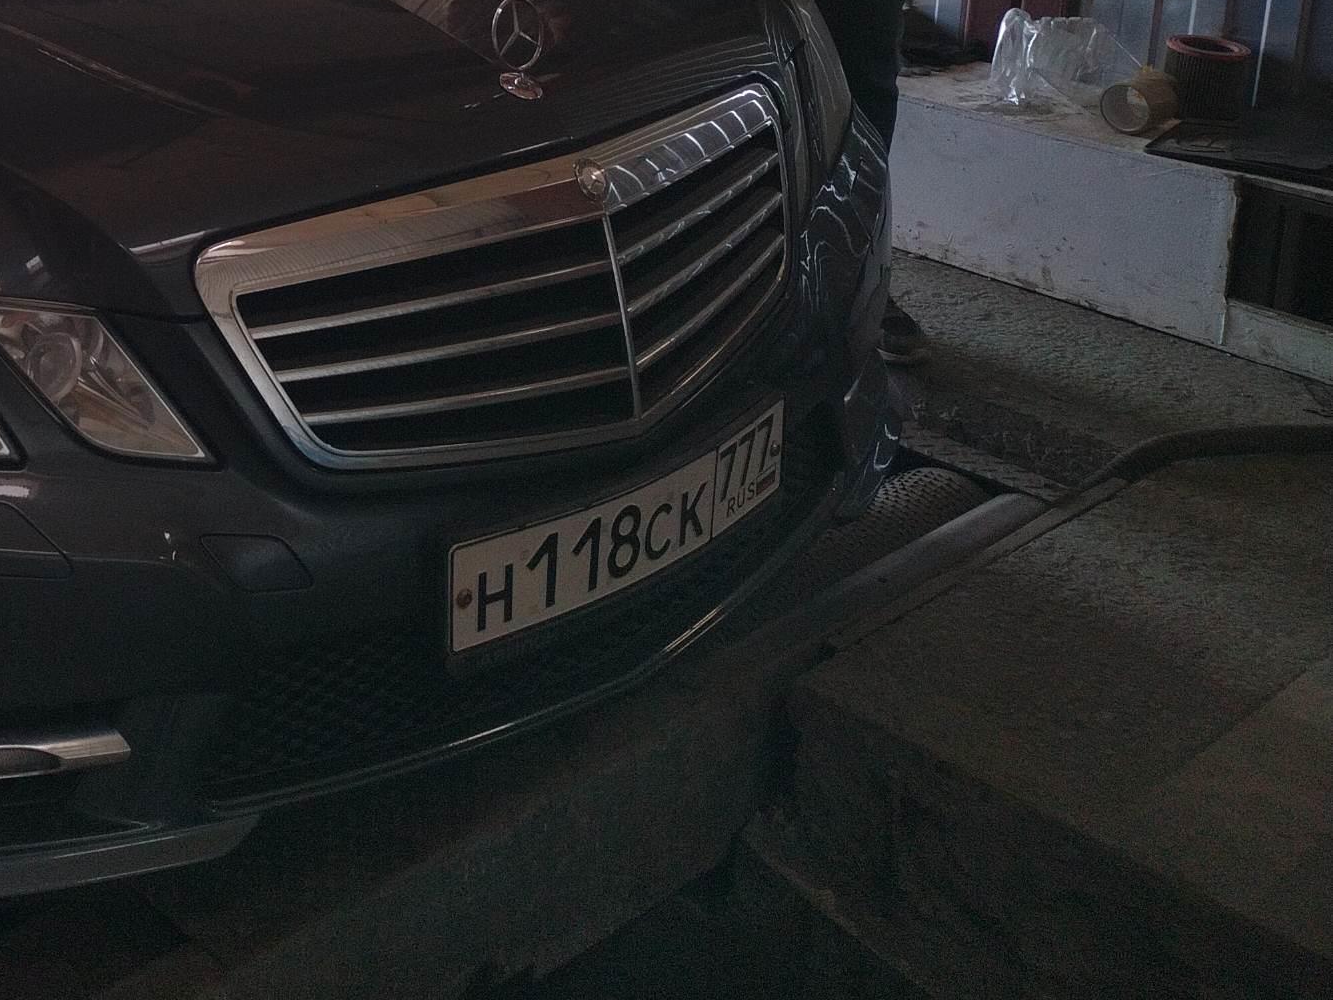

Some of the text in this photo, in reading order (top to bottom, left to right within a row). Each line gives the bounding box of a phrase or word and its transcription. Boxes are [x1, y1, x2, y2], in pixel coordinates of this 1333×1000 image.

[476, 413, 774, 632] Н118СК 777
[727, 482, 755, 516] RUS
